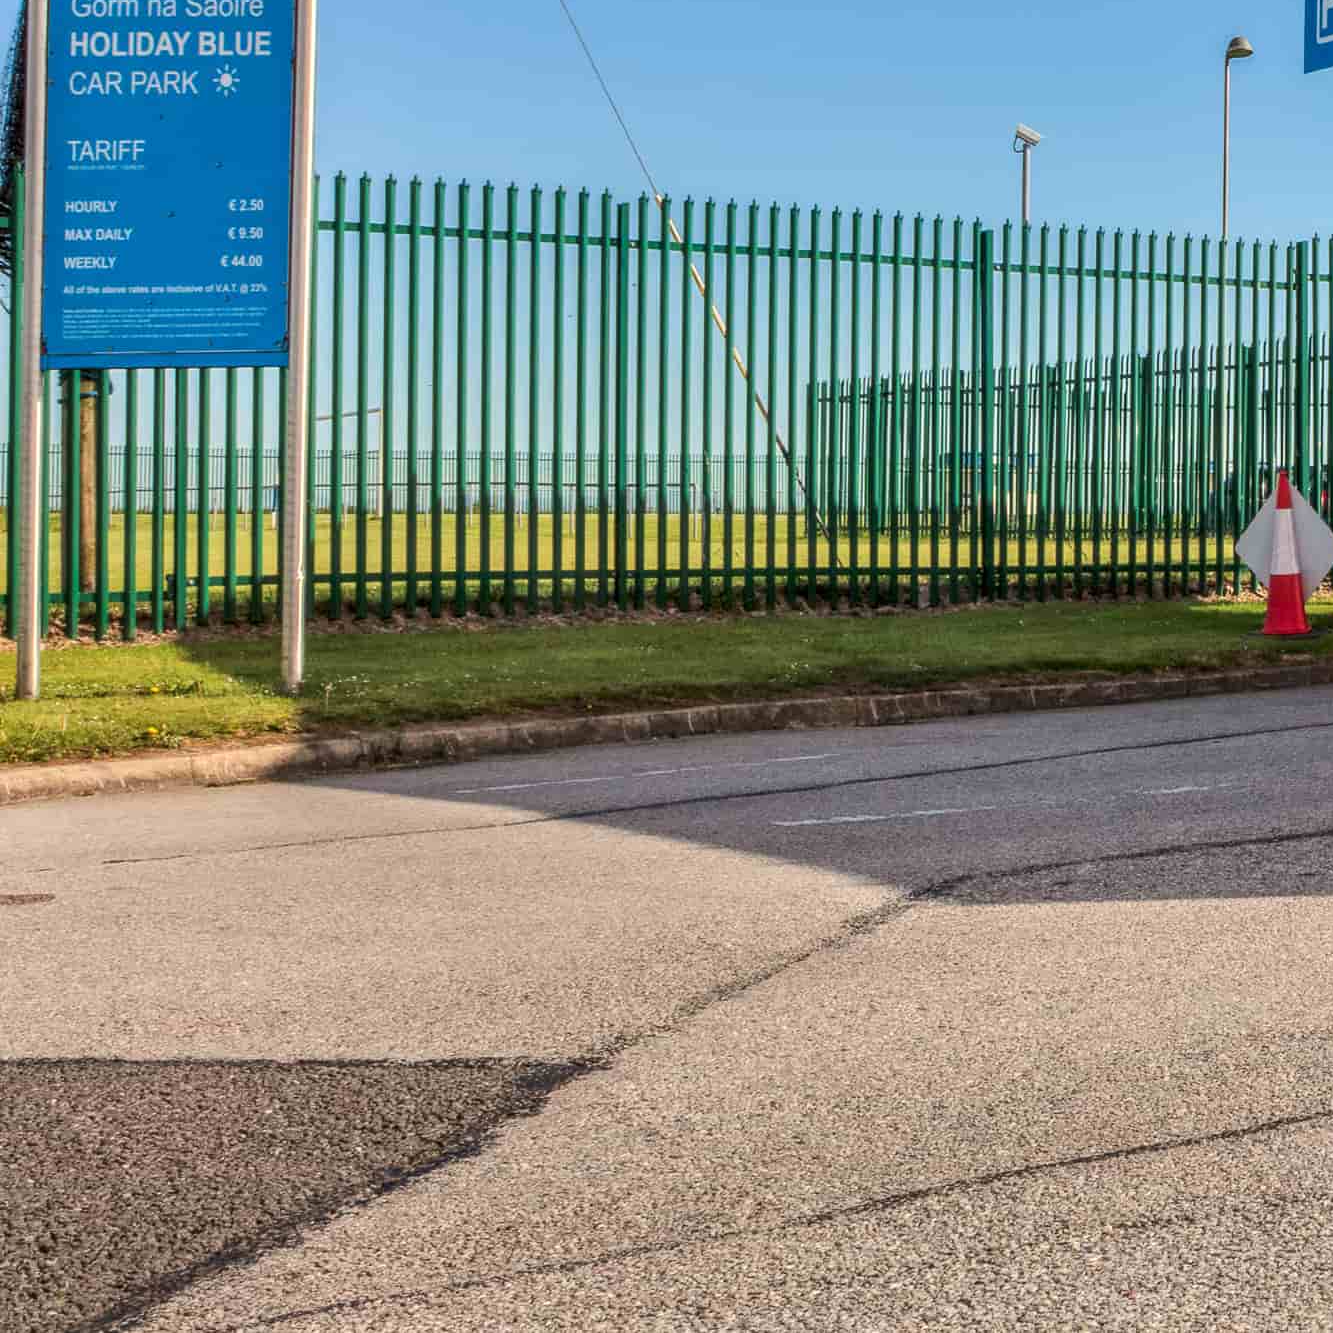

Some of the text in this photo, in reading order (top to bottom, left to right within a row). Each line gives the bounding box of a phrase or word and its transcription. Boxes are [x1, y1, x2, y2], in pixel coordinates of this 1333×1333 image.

[69, 30, 273, 58] HOLIDAY BLUE
[69, 70, 199, 96] CAR PARK
[67, 139, 145, 162] TARIFF
[65, 199, 264, 213] HOURLY € 2.50
[64, 228, 93, 242] MAX
[95, 227, 134, 241] DAILY
[227, 228, 237, 240] €
[63, 254, 263, 269] WEEKLY € 44.00
